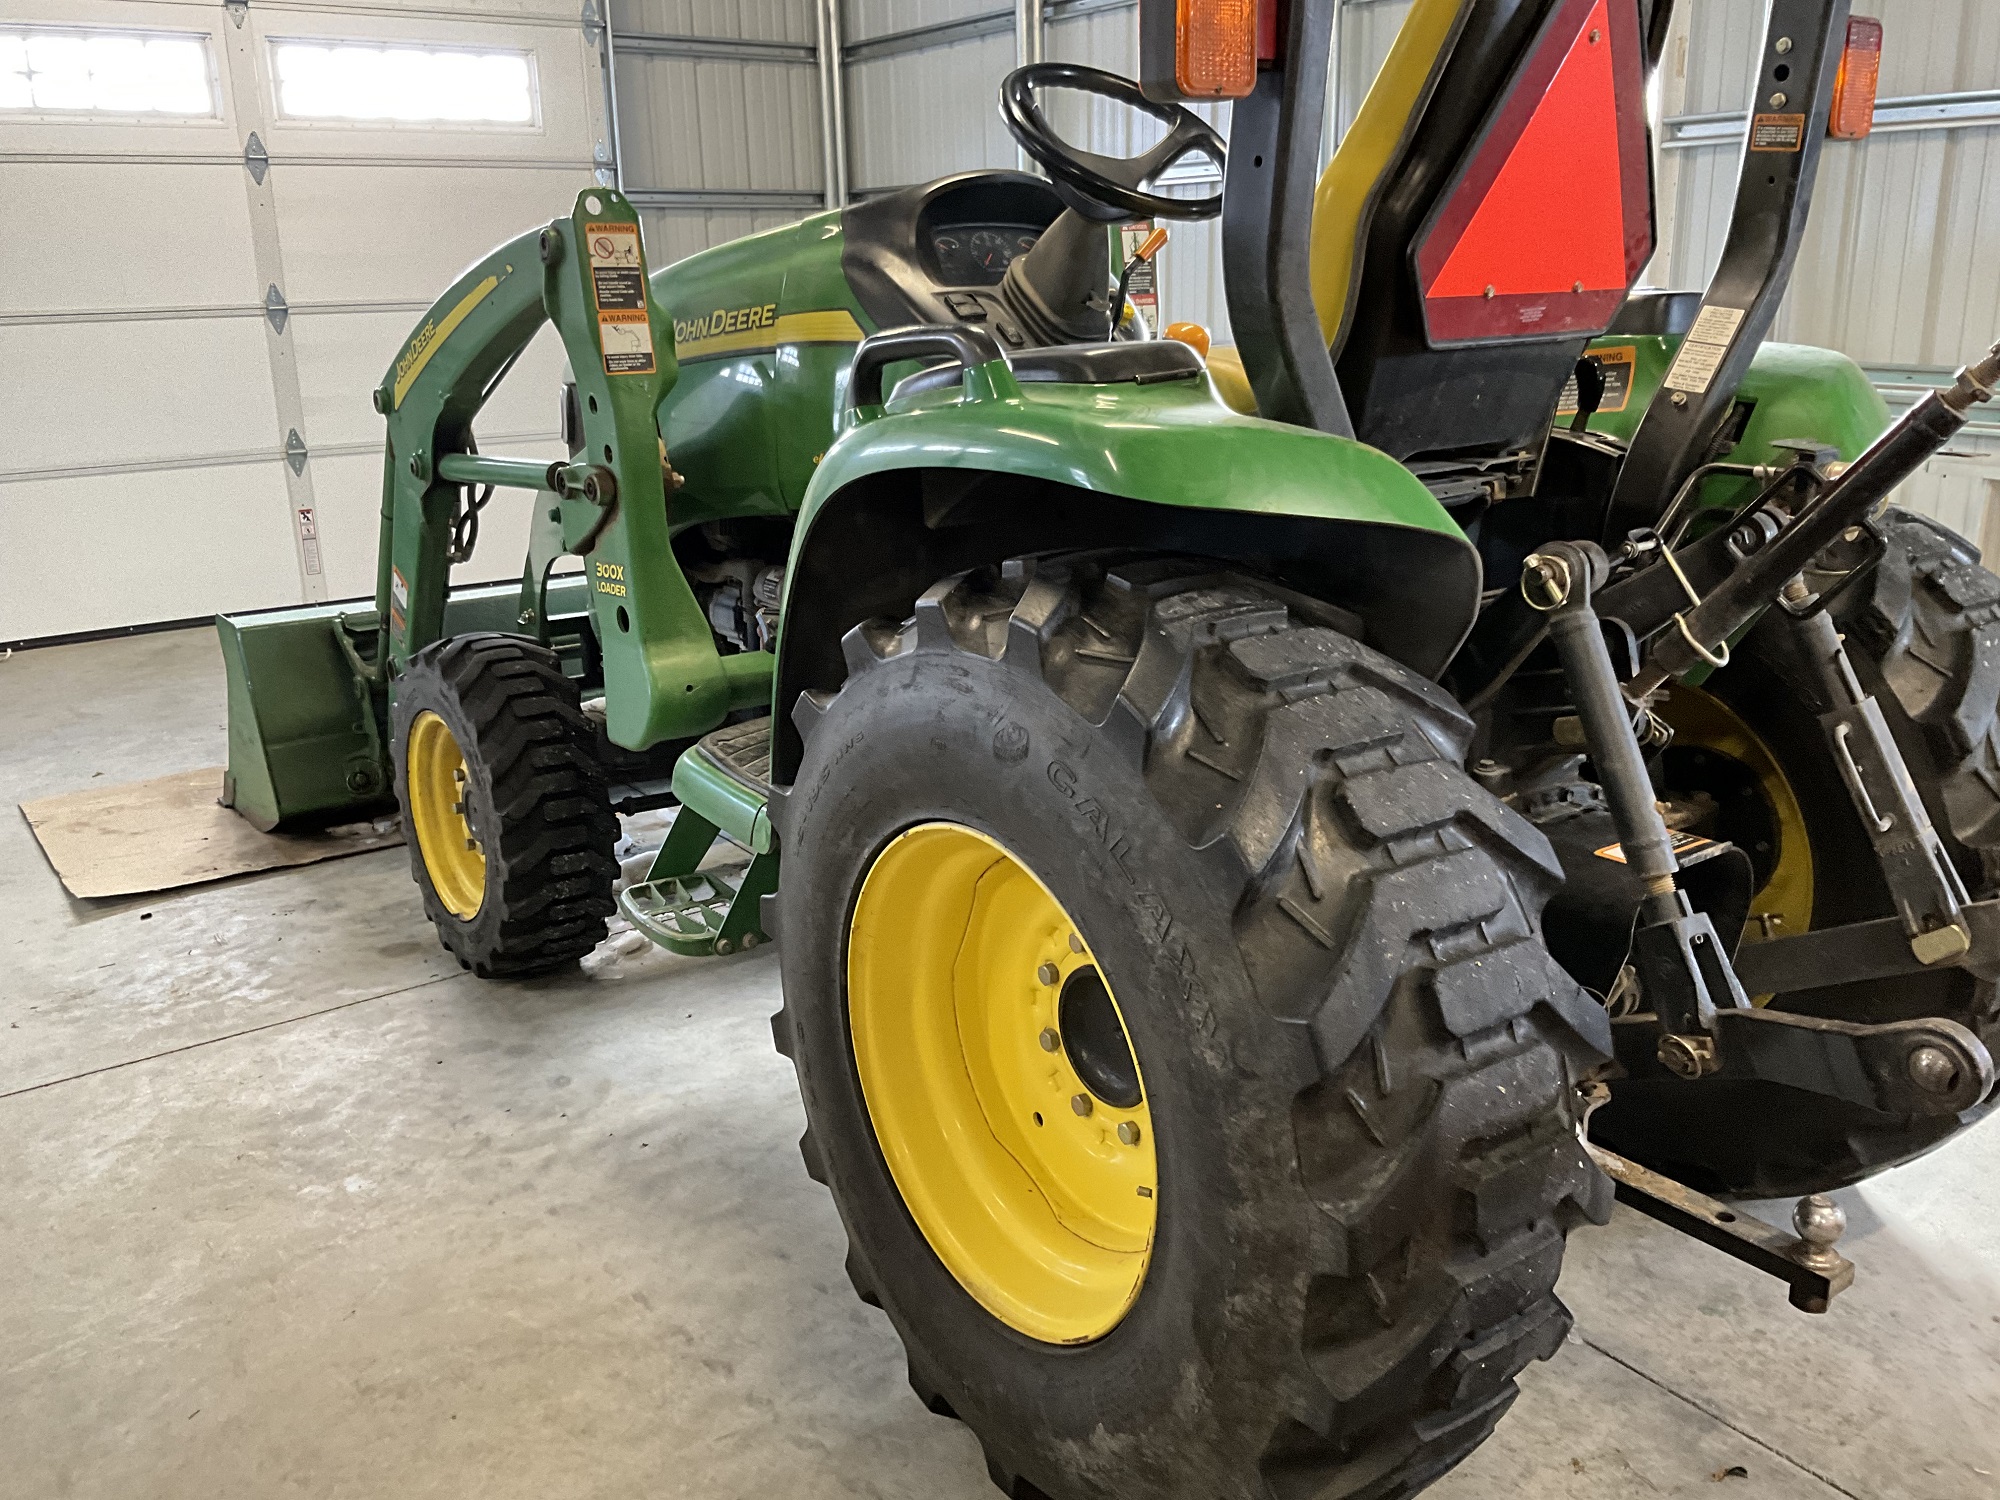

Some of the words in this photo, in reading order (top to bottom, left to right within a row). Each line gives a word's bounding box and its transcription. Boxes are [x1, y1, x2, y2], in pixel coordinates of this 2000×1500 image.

[595, 224, 634, 232] WARNING
[608, 313, 646, 323] WARNING
[709, 304, 777, 334] DEERE
[396, 347, 414, 384] JOHN
[410, 318, 437, 360] DEERE
[596, 562, 624, 580] 300X
[596, 581, 626, 597] LOADER
[1046, 758, 1230, 1072] GALAXY
